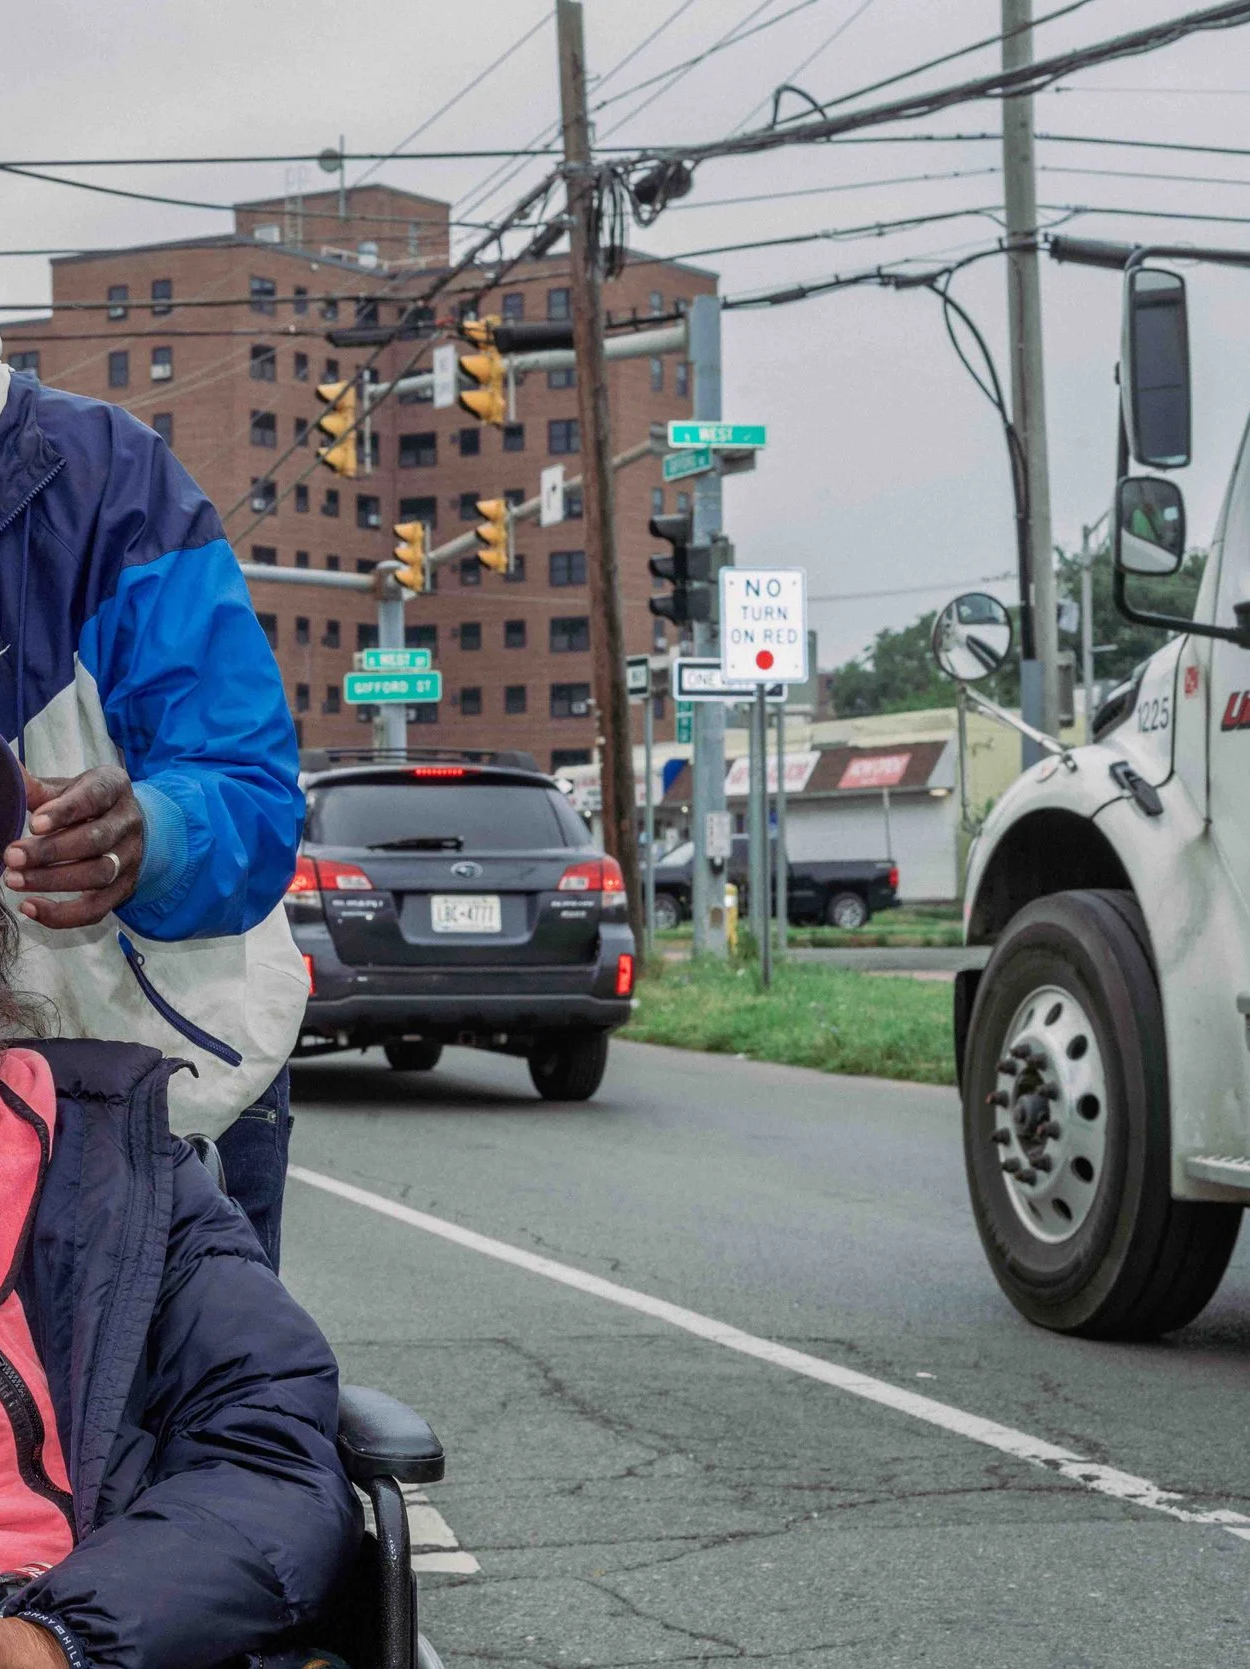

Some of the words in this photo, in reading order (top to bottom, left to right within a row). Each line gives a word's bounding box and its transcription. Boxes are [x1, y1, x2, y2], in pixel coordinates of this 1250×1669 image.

[745, 579, 781, 597] NO
[741, 605, 787, 621] TURN
[731, 628, 755, 644] ON
[763, 628, 798, 644] RED
[1138, 697, 1169, 732] 1225
[17, 1610, 56, 1625] TOMMY
